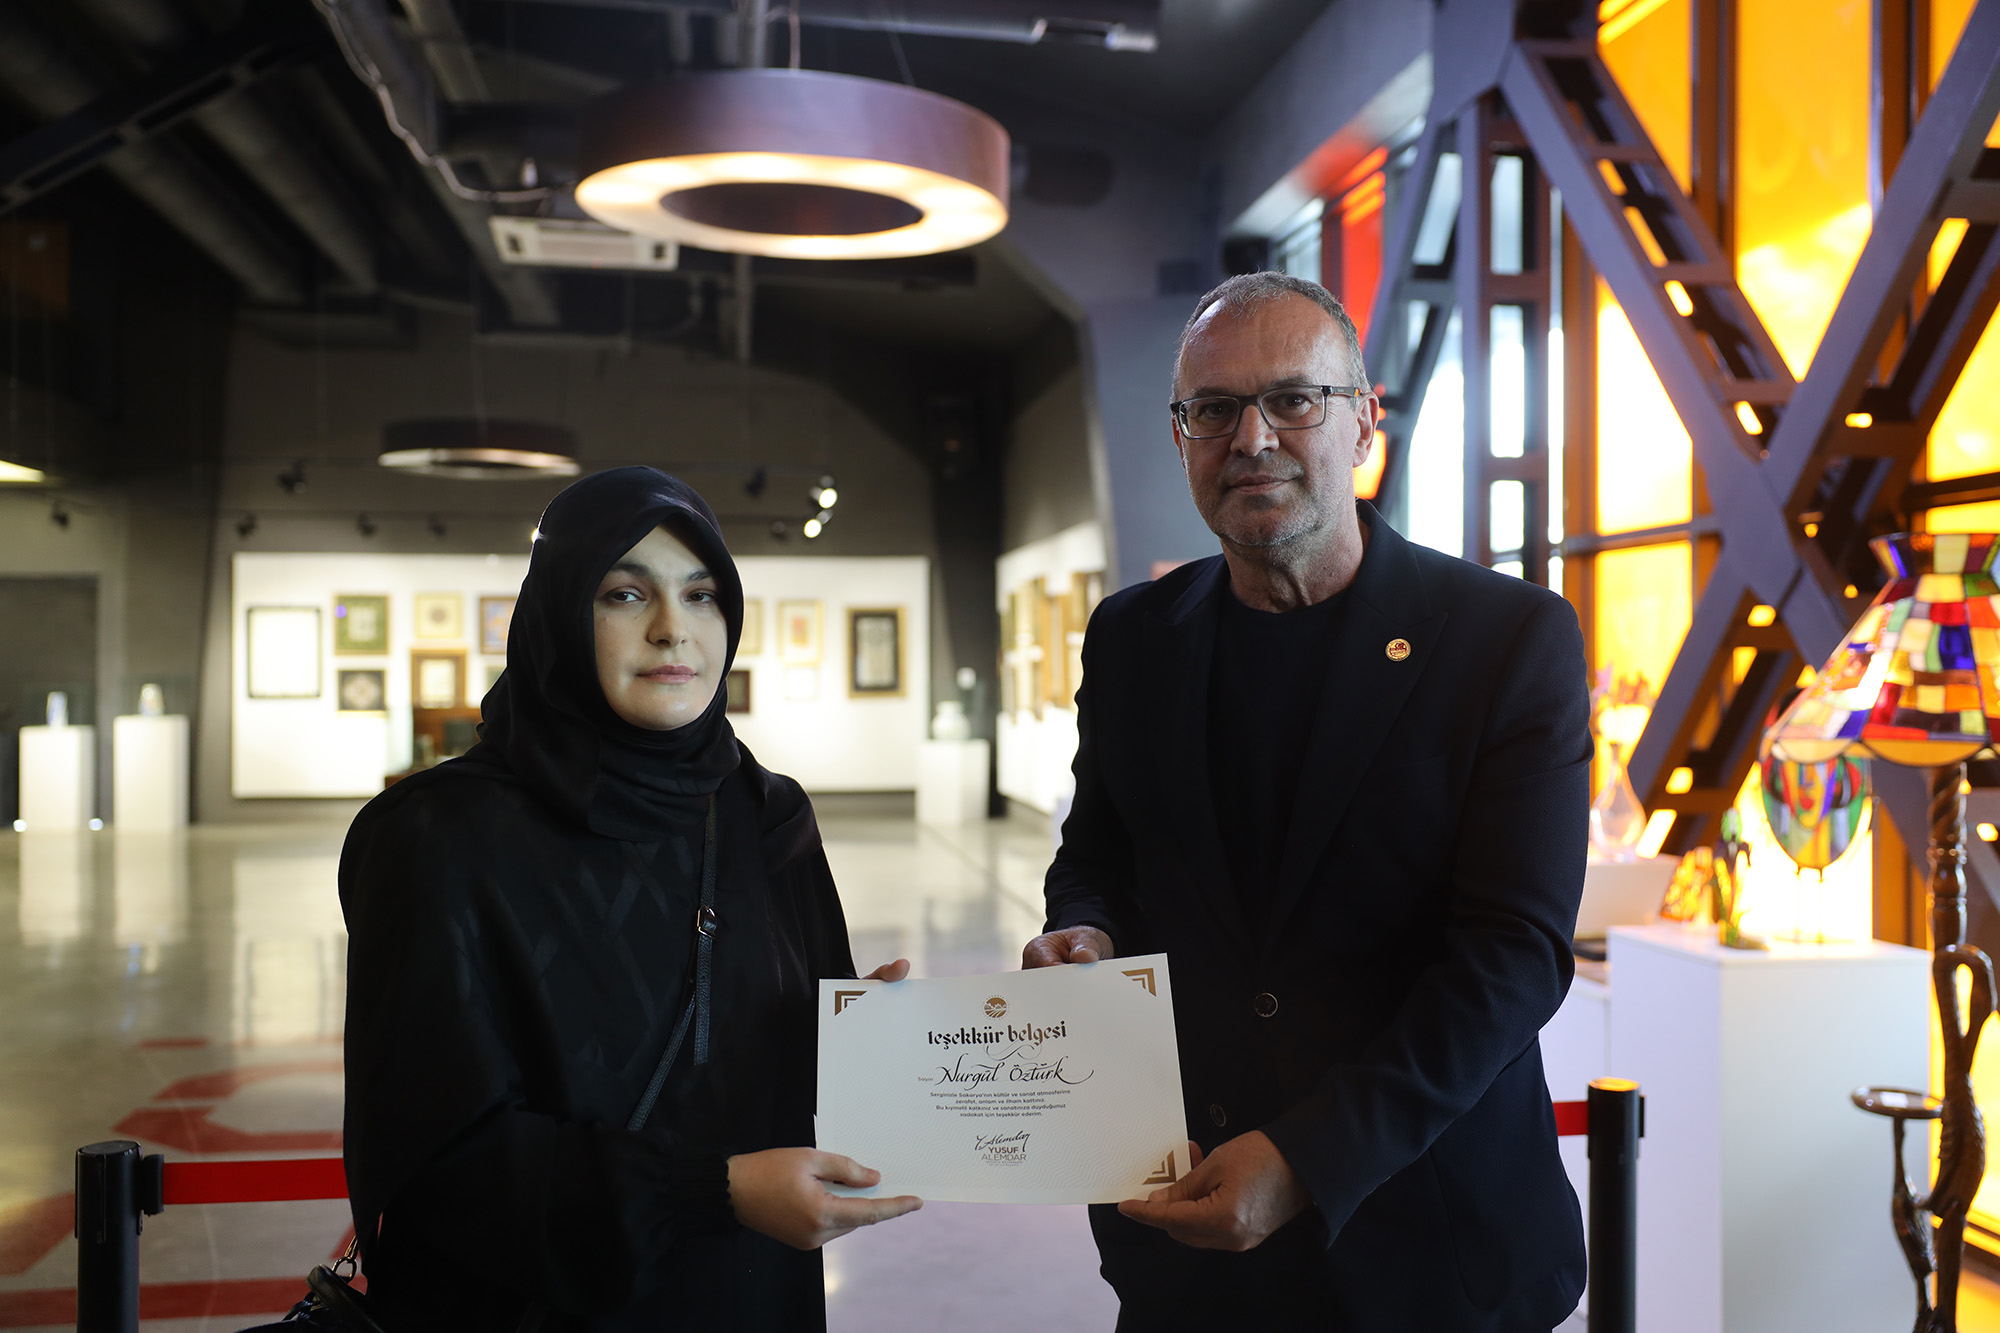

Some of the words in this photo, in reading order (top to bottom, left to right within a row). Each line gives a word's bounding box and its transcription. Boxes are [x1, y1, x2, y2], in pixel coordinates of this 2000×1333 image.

[928, 1026, 1004, 1050] teşekkür
[1007, 1020, 1066, 1046] belgesi
[934, 1053, 1005, 1092] Nurgül
[1009, 1055, 1095, 1085] Öztürk
[981, 1153, 1027, 1161] ALEMDAR
